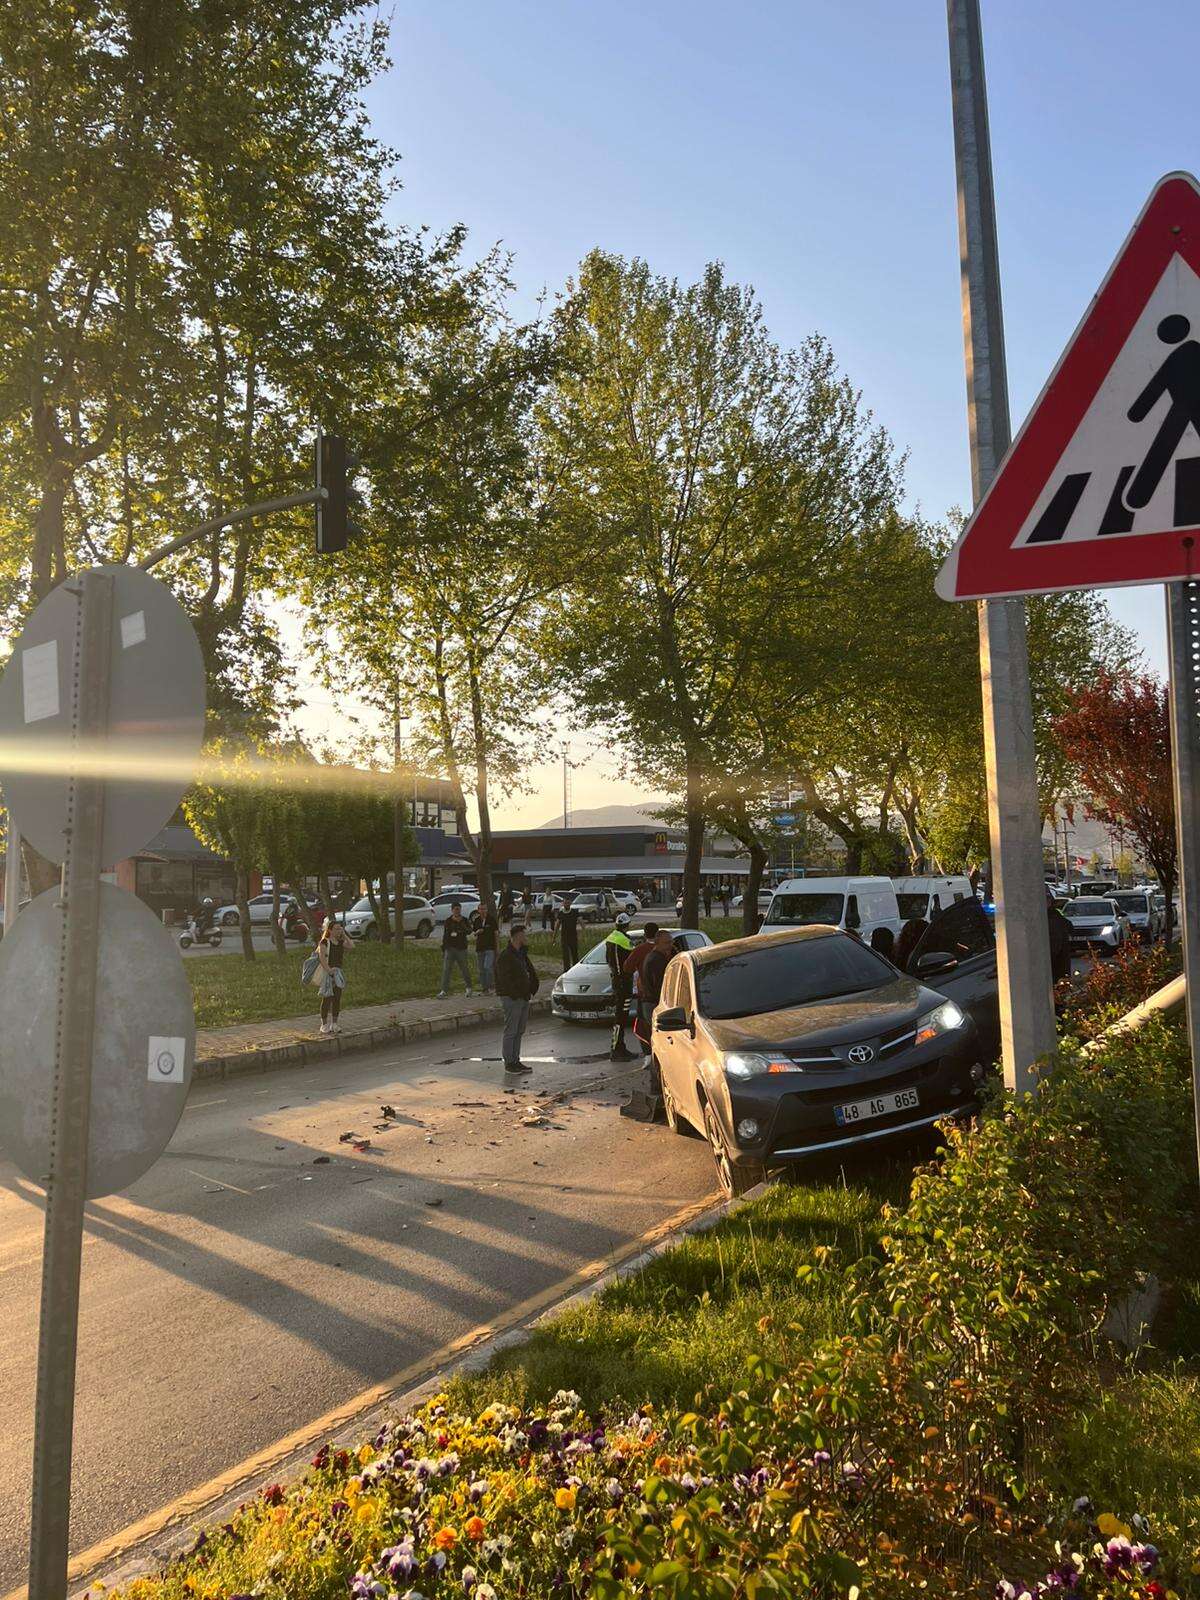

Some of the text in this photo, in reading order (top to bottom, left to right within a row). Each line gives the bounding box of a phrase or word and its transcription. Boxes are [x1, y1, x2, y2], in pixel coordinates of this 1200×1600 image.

[844, 1091, 917, 1120] 48 AG 865
